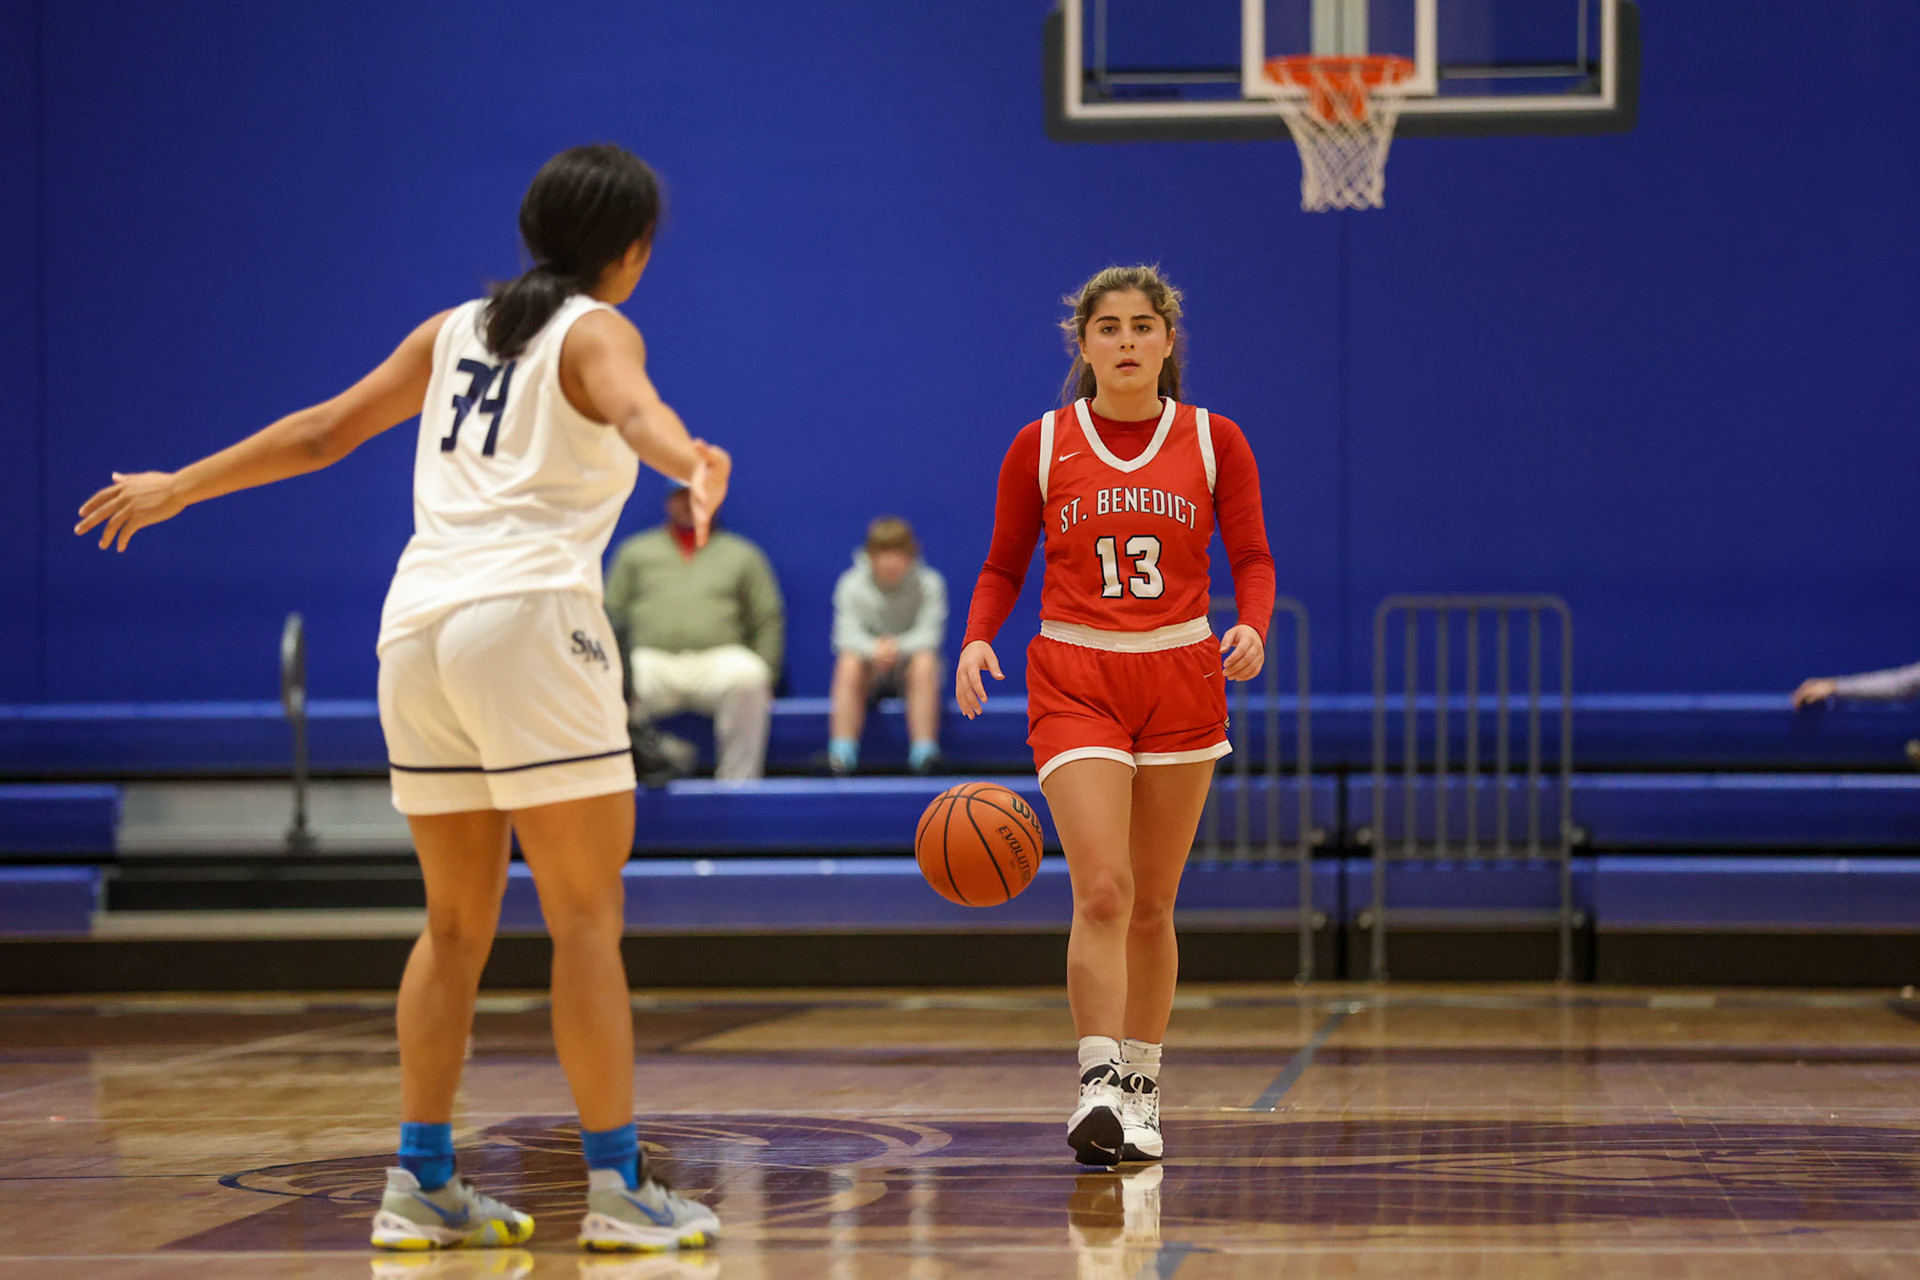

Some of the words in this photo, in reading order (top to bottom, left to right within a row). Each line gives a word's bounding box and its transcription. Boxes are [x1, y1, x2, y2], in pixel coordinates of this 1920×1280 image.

[440, 358, 516, 456] 34
[1061, 497, 1088, 533] ST.
[1097, 487, 1197, 530] BENEDICT
[1095, 535, 1165, 599] 13
[998, 825, 1032, 881] EVOLUT
